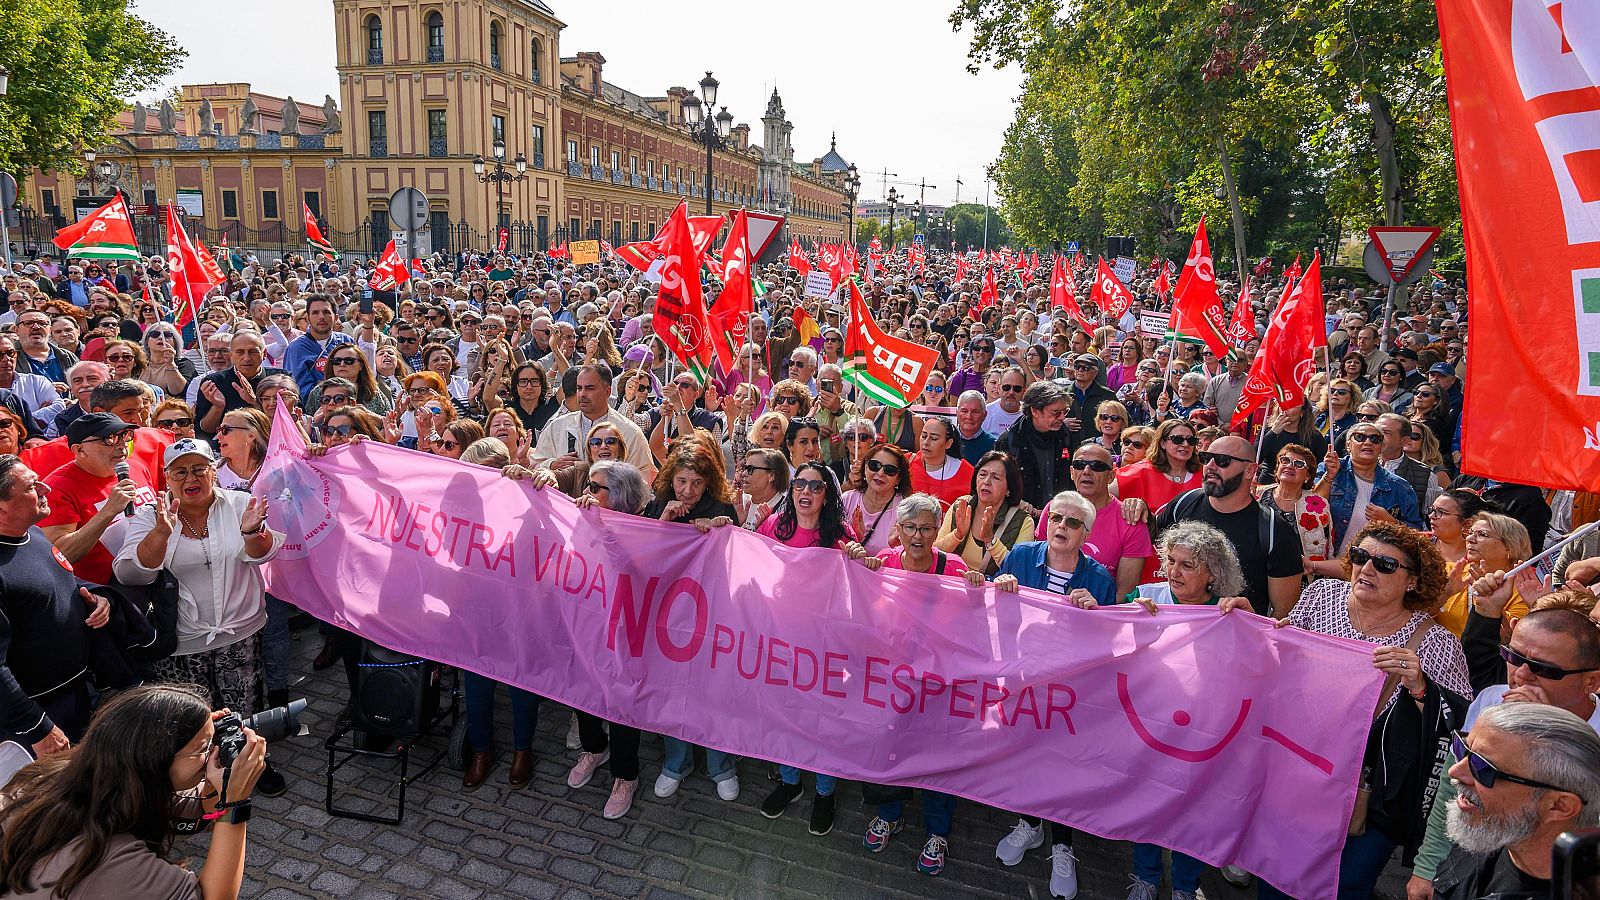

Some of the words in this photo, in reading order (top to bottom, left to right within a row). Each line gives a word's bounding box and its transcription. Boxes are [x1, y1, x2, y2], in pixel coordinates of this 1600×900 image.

[304, 521, 328, 541] Mam
[365, 492, 516, 577] NUESTRA
[533, 535, 607, 609] VIDA
[606, 573, 709, 663] NO
[711, 623, 849, 699] PUEDE
[862, 655, 1077, 736] ESPERAR
[177, 822, 195, 831] OS
